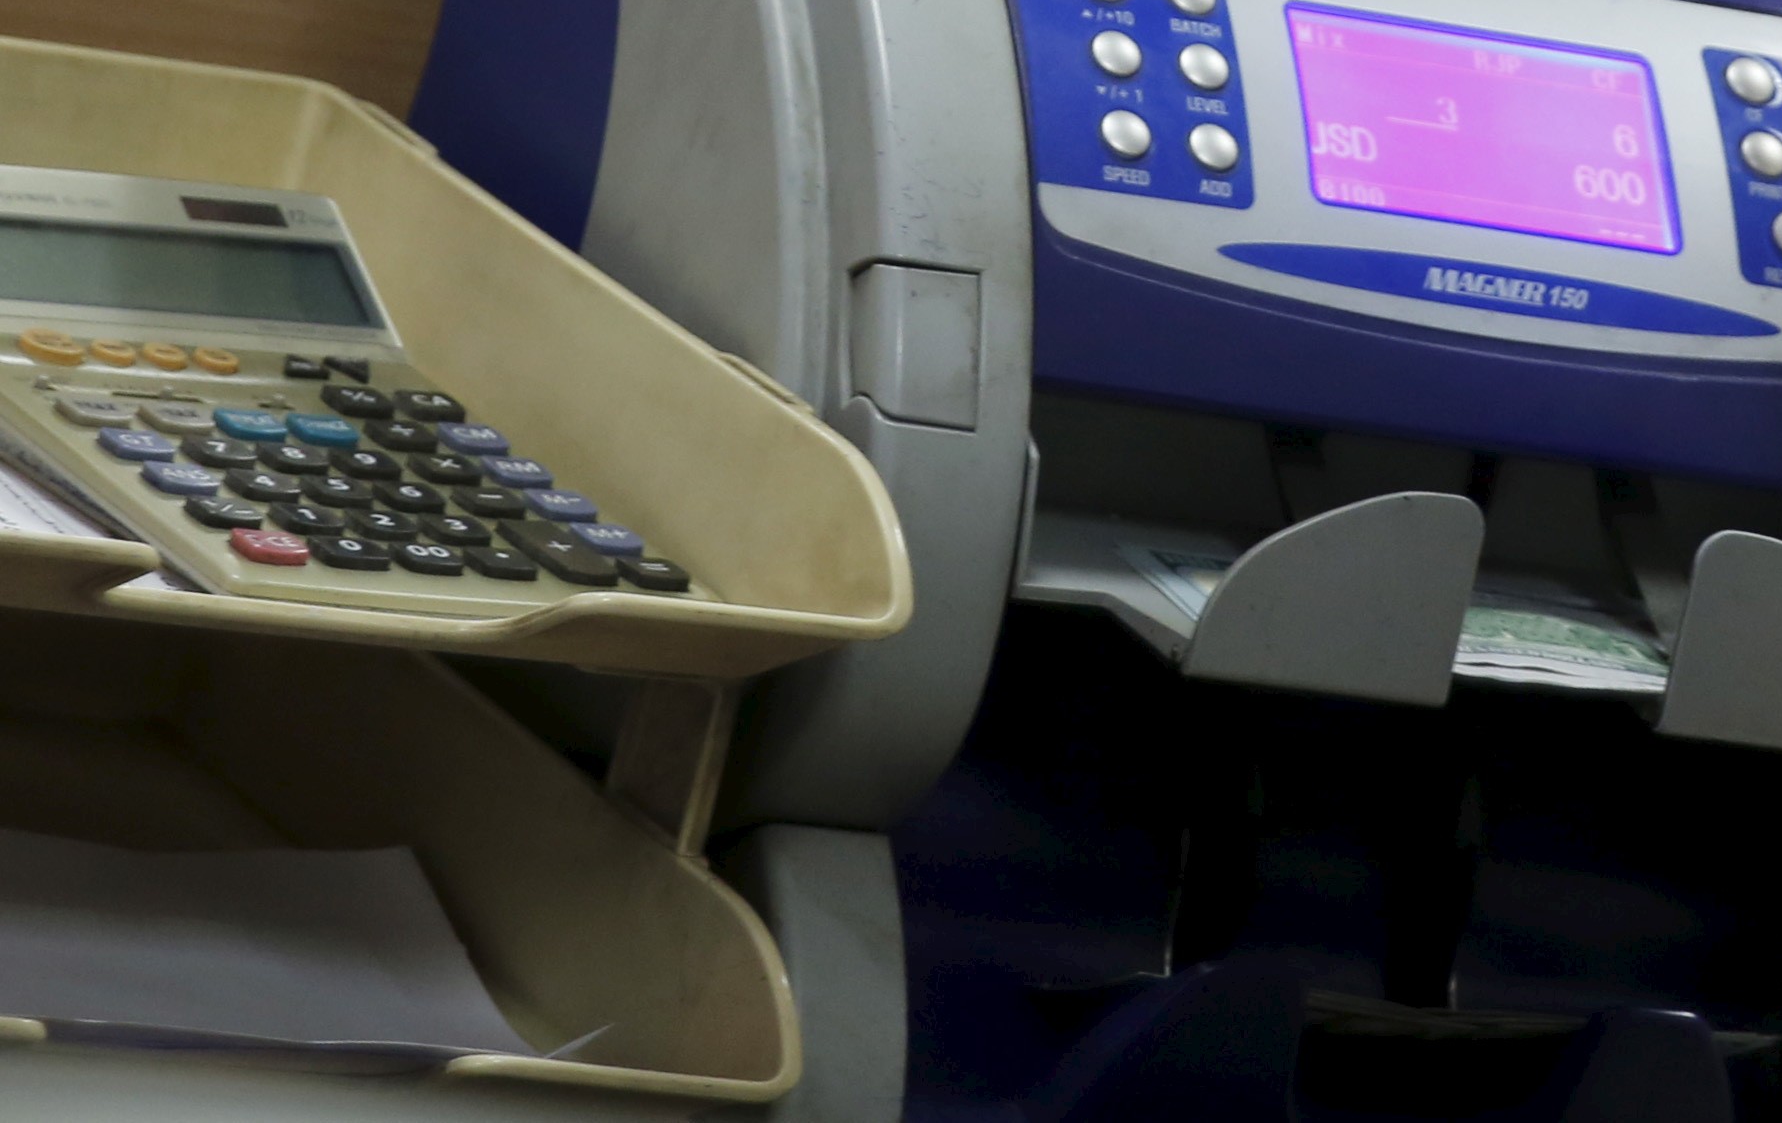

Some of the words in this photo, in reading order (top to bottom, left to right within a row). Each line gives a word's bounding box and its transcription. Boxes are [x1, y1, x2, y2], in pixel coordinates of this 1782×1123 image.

[1170, 18, 1222, 38] BATCH
[1186, 96, 1229, 116] LEVEL
[1613, 123, 1639, 159] 6
[1103, 165, 1151, 186] SPEED
[1200, 179, 1233, 197] ADD
[1574, 164, 1646, 206] 600
[1423, 266, 1547, 306] MAGNER
[1549, 284, 1590, 311] 150
[117, 432, 155, 448] GT
[206, 440, 226, 453] 7
[281, 446, 306, 460] 8
[353, 453, 378, 465] 9
[254, 474, 276, 487] 4
[326, 478, 350, 491] 5
[399, 486, 423, 498] 6
[297, 508, 317, 520] 1
[370, 513, 396, 526] 2
[444, 518, 469, 531] 3
[338, 539, 363, 552] 0
[404, 544, 451, 559] 00
